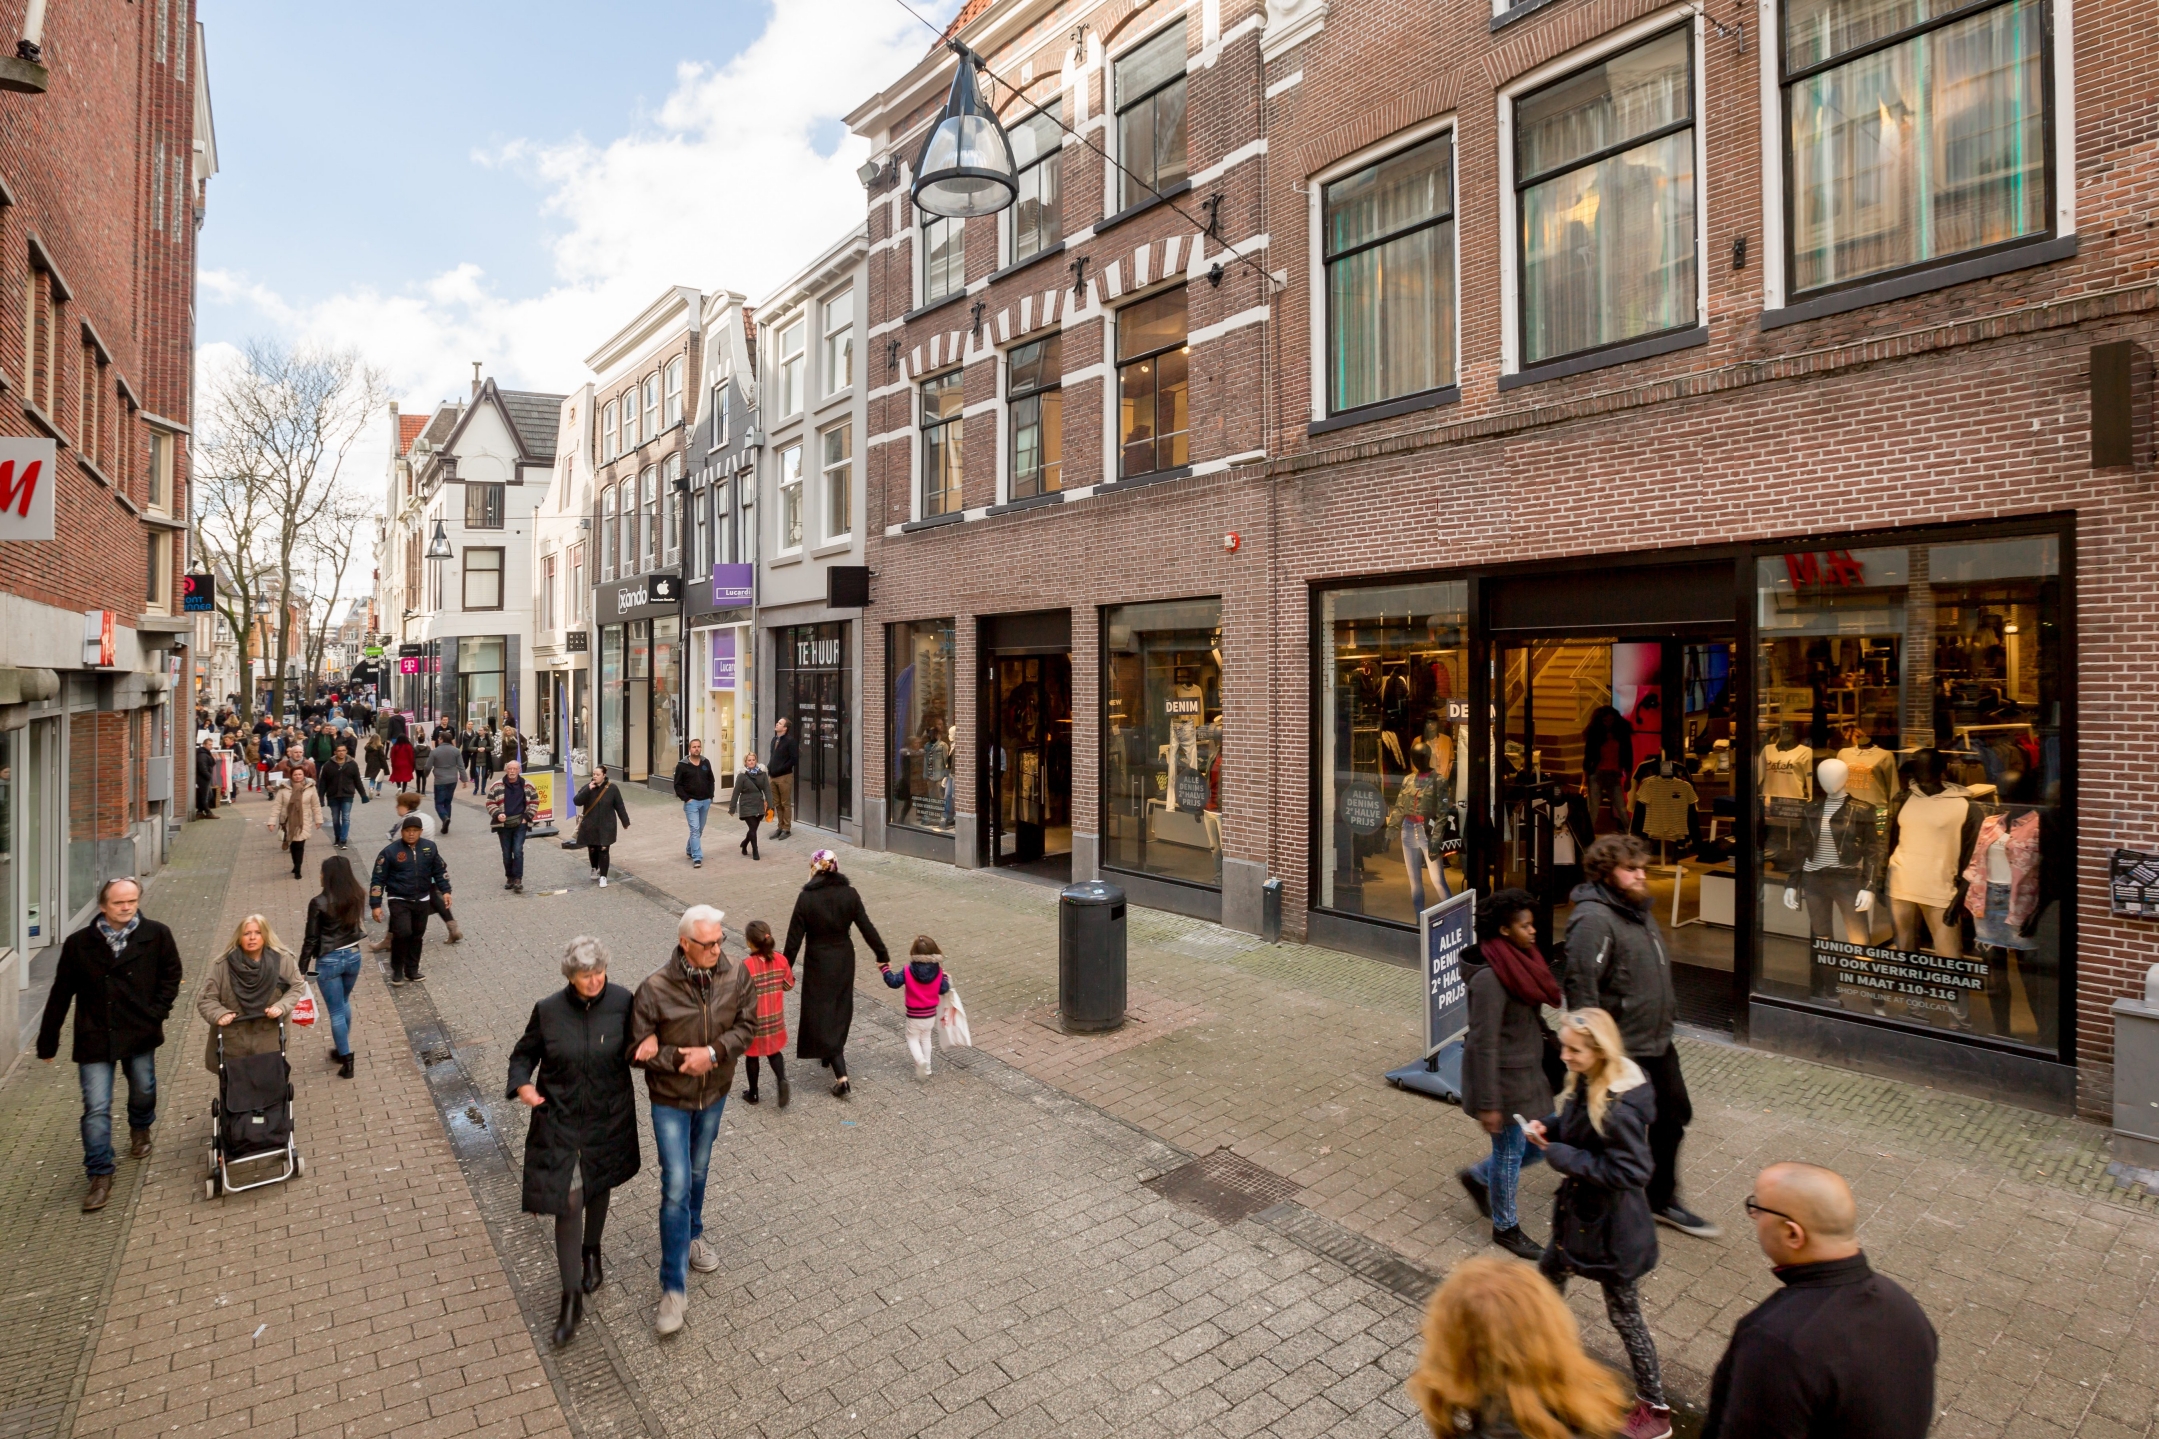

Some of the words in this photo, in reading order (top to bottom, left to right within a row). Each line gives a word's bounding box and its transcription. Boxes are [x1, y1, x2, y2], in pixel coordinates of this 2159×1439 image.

[619, 585, 648, 612] xando
[725, 588, 751, 596] Lucardi
[798, 642, 809, 665] TE
[1166, 701, 1198, 712] DENIM
[1184, 776, 1199, 784] ALLE
[1185, 792, 1205, 800] HALVE
[1353, 790, 1373, 799] ALLE
[1183, 799, 1200, 807] PRIJS
[1347, 799, 1379, 809] DENIMS
[1351, 816, 1375, 826] PRIJS
[1354, 808, 1380, 818] HALVE
[1440, 928, 1462, 952] ALLE
[1813, 939, 1863, 956] JUNIOR
[1865, 947, 1907, 962] GIRLS
[1909, 954, 1989, 975] COLLECTIE
[1443, 967, 1461, 989] HAL
[1817, 954, 1836, 966] NU
[1839, 958, 1870, 971] OOK
[1871, 962, 1982, 990] VERKRIJGBAAR
[1839, 972, 1854, 983] IN
[1857, 975, 1895, 990] MAAT
[1898, 982, 1956, 1001] 110-116
[1438, 983, 1466, 1010] PRIJS
[1835, 986, 1859, 996] SHOP
[1860, 990, 1892, 1002] ONLINE
[1893, 996, 1904, 1004] AT
[1906, 998, 1961, 1015] COOLCAT.NL
